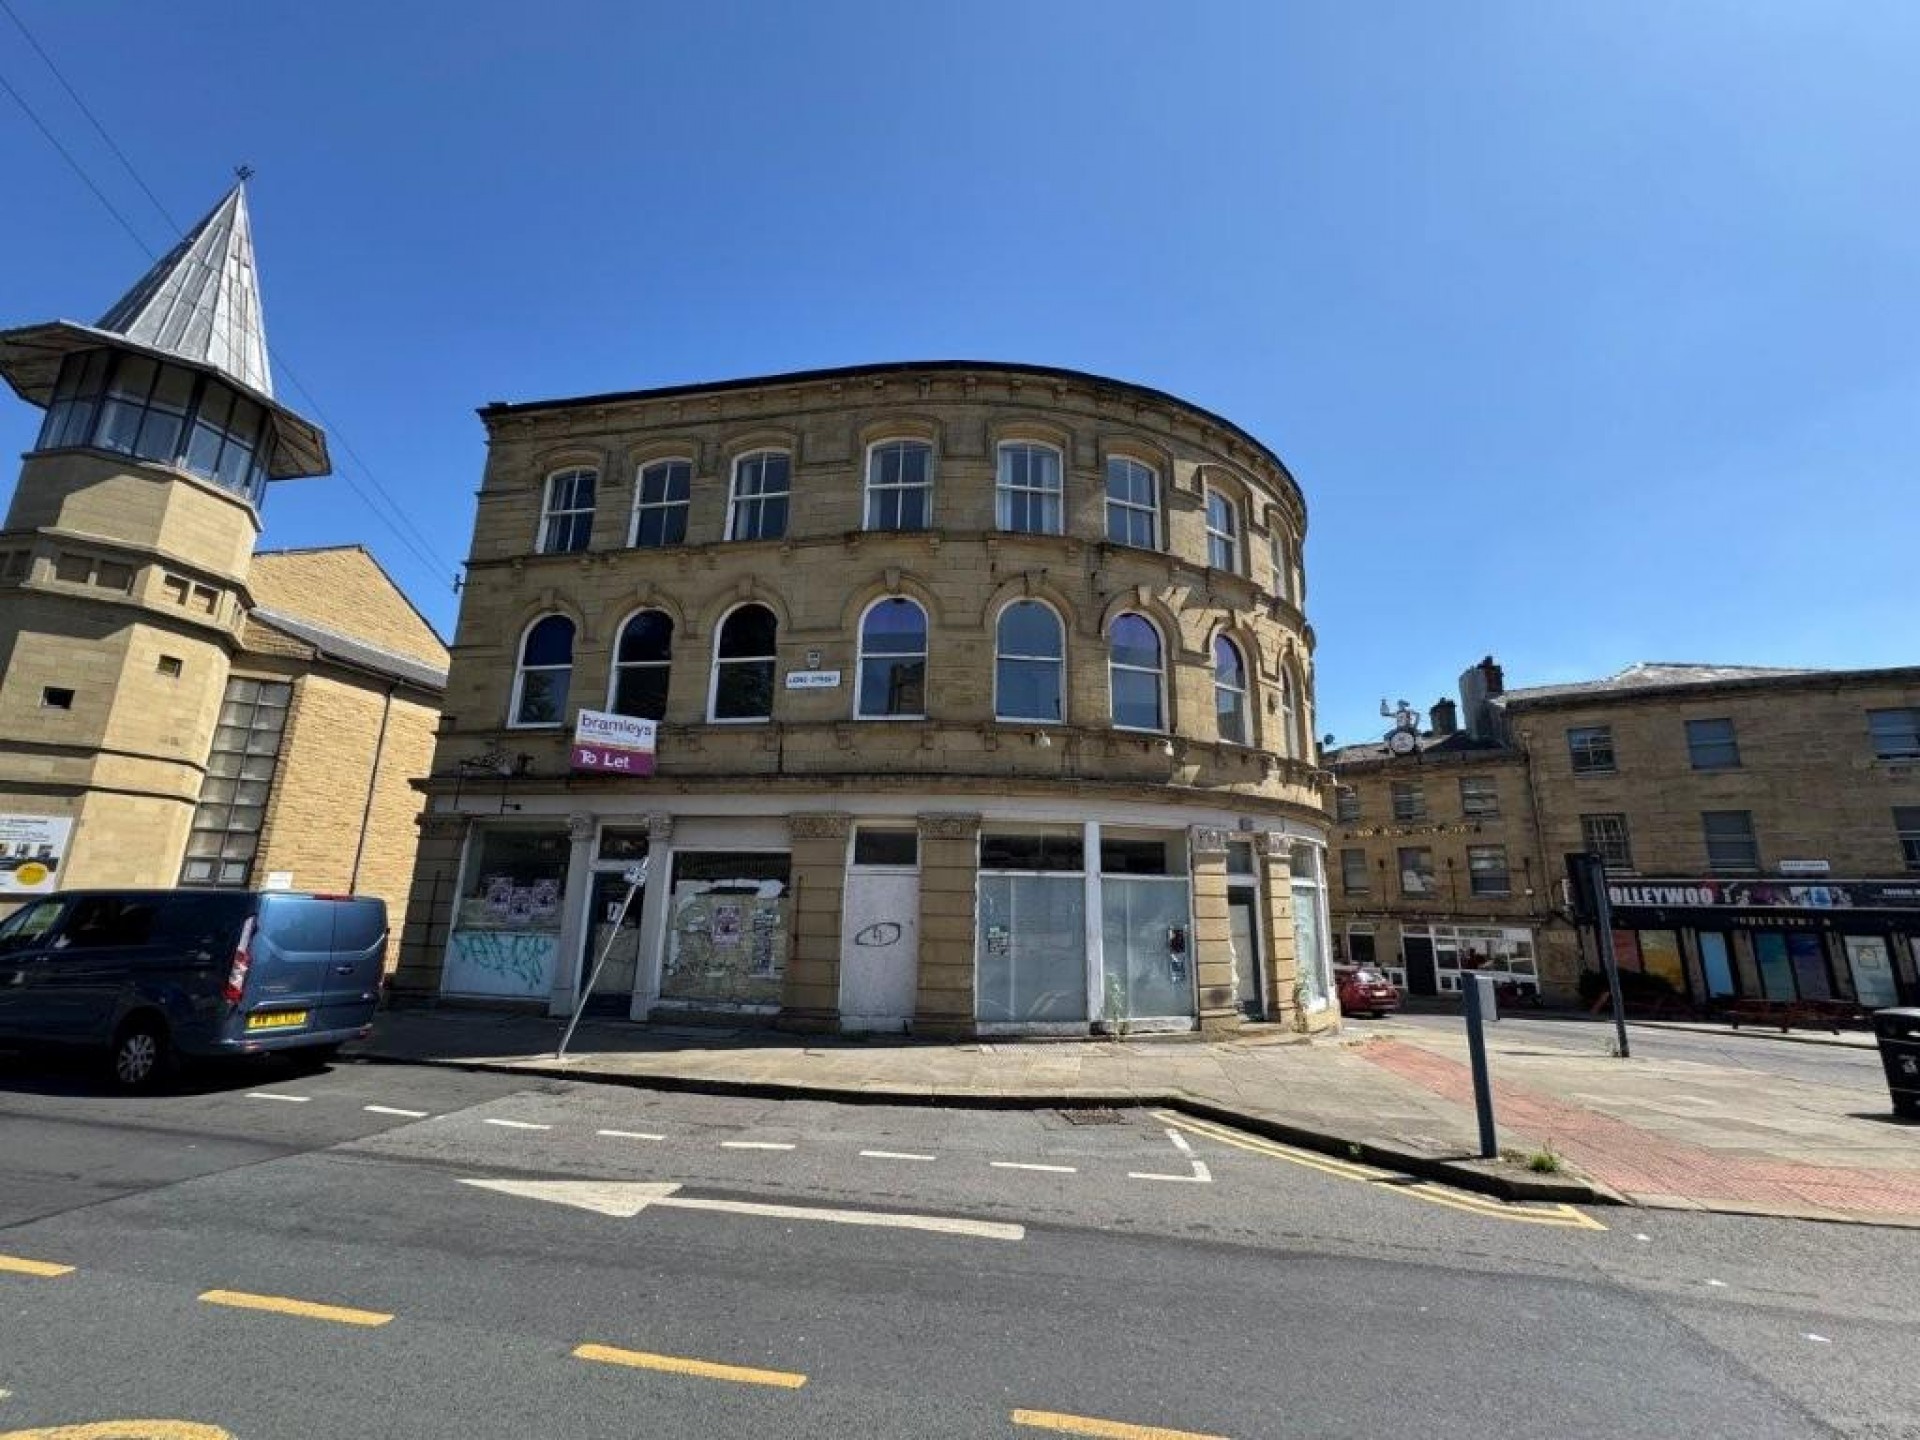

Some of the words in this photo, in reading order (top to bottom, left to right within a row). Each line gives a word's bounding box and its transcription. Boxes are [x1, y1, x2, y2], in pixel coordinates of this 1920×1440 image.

[582, 713, 652, 737] bramleys
[580, 749, 597, 764] To
[603, 751, 630, 769] Let
